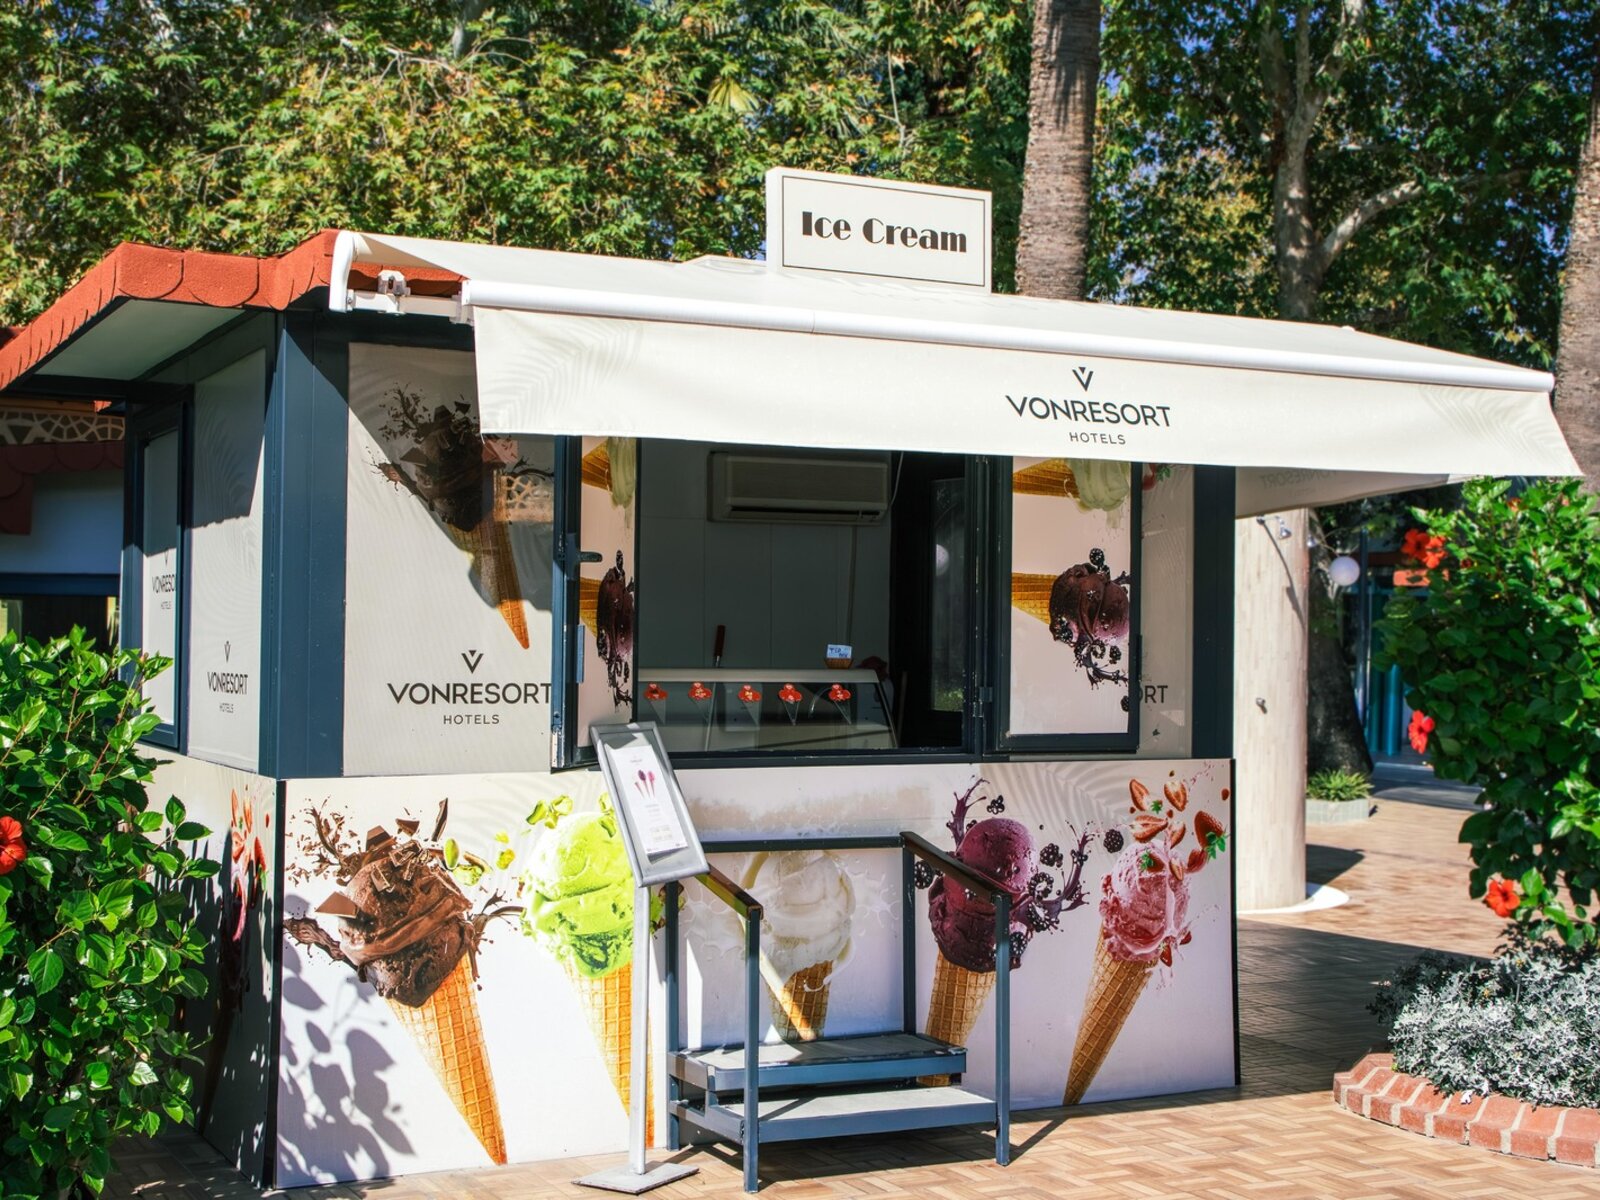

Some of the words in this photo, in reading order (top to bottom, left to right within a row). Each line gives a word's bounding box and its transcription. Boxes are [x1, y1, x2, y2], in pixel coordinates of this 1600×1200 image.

[802, 211, 851, 240] Ice
[862, 217, 967, 253] Cream
[1005, 395, 1170, 427] VONRESORT
[1069, 432, 1126, 445] HOTELS
[207, 672, 248, 695] VONRESORT
[387, 682, 552, 705] VONRESORT
[443, 714, 500, 725] HOTELS
